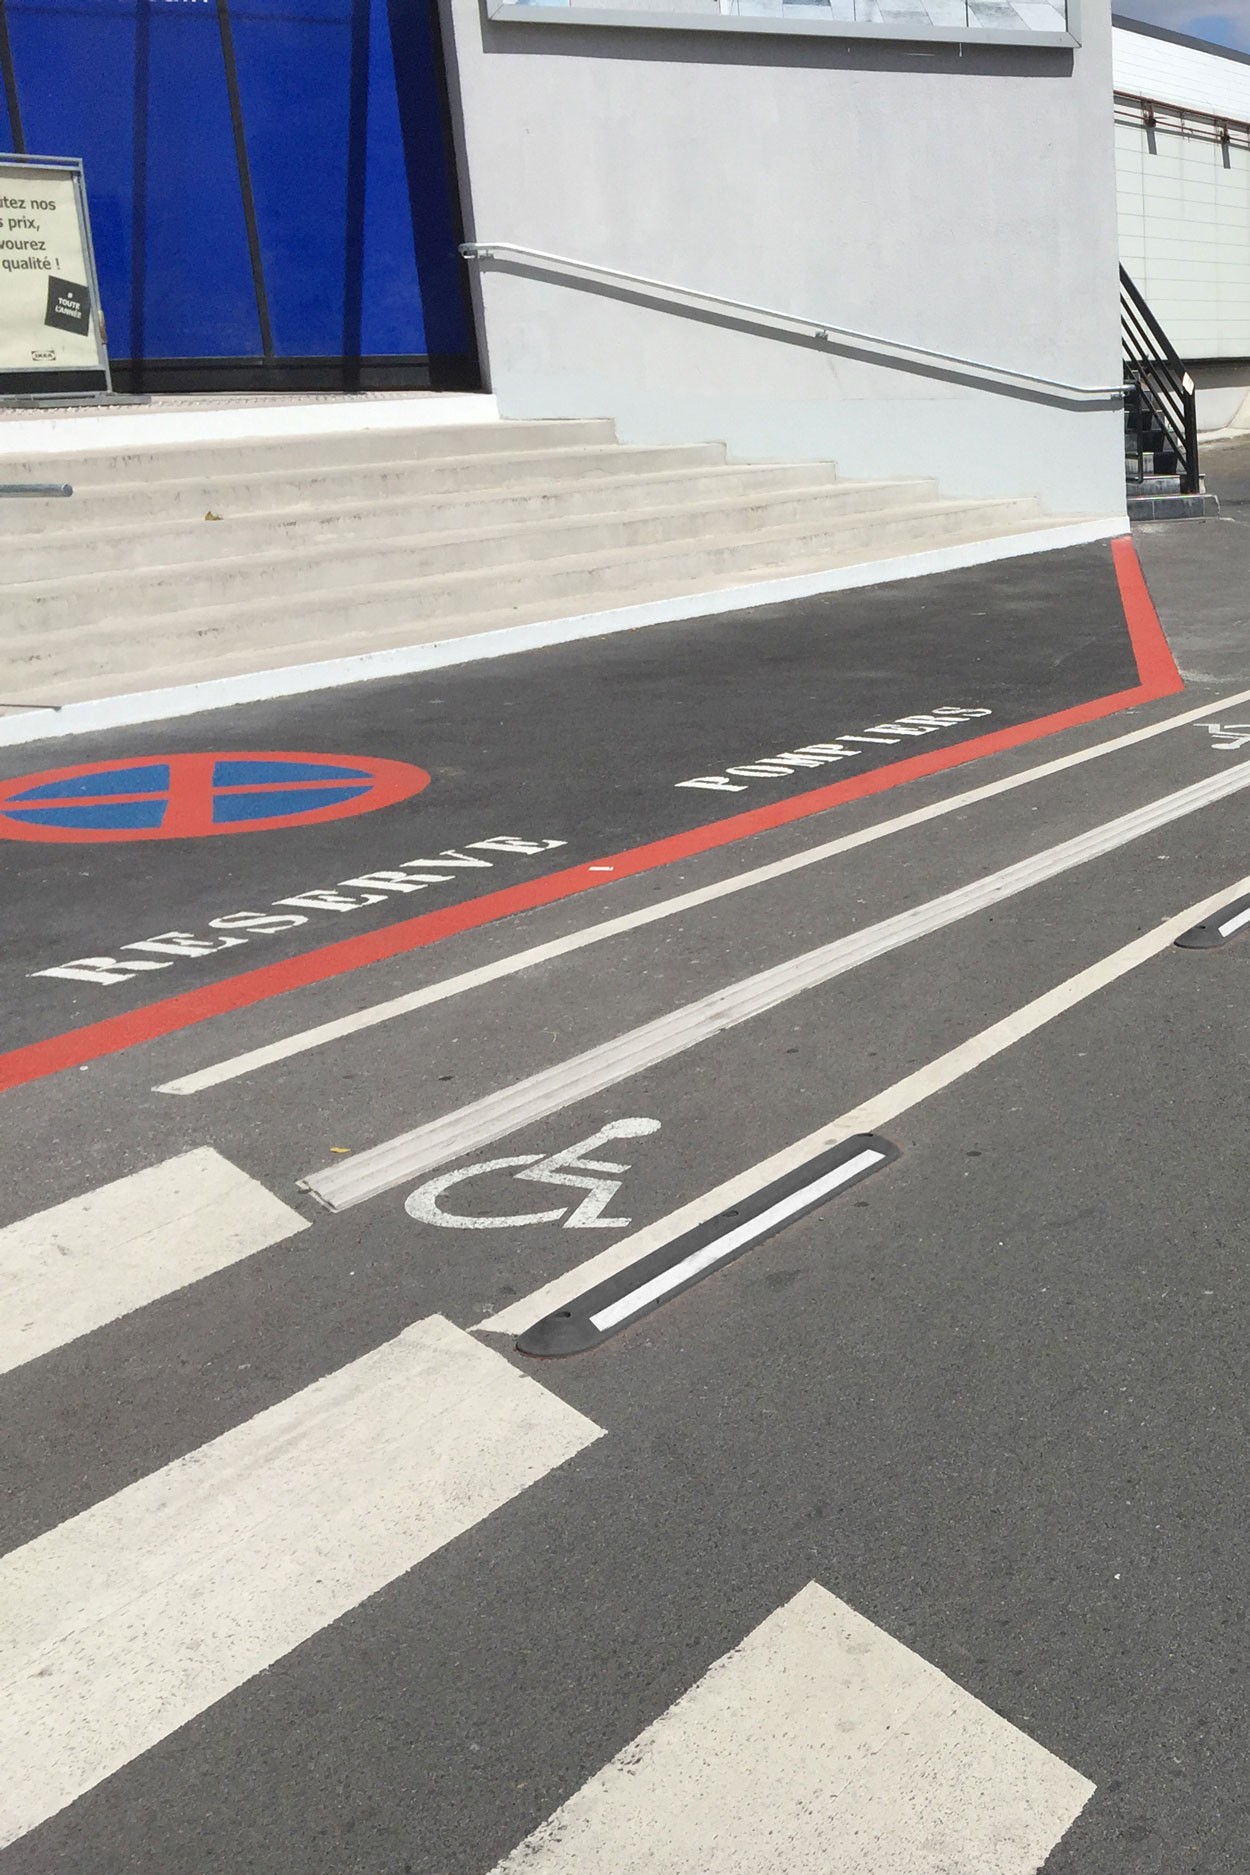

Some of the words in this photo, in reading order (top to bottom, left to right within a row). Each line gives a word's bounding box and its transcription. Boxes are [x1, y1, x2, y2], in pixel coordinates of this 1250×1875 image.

[30, 200, 56, 211] nos
[8, 215, 40, 232] prix,
[2, 255, 52, 273] qualité
[58, 297, 81, 310] TOUTE
[26, 835, 569, 987] RESERVE
[674, 706, 993, 793] POMPIERS
